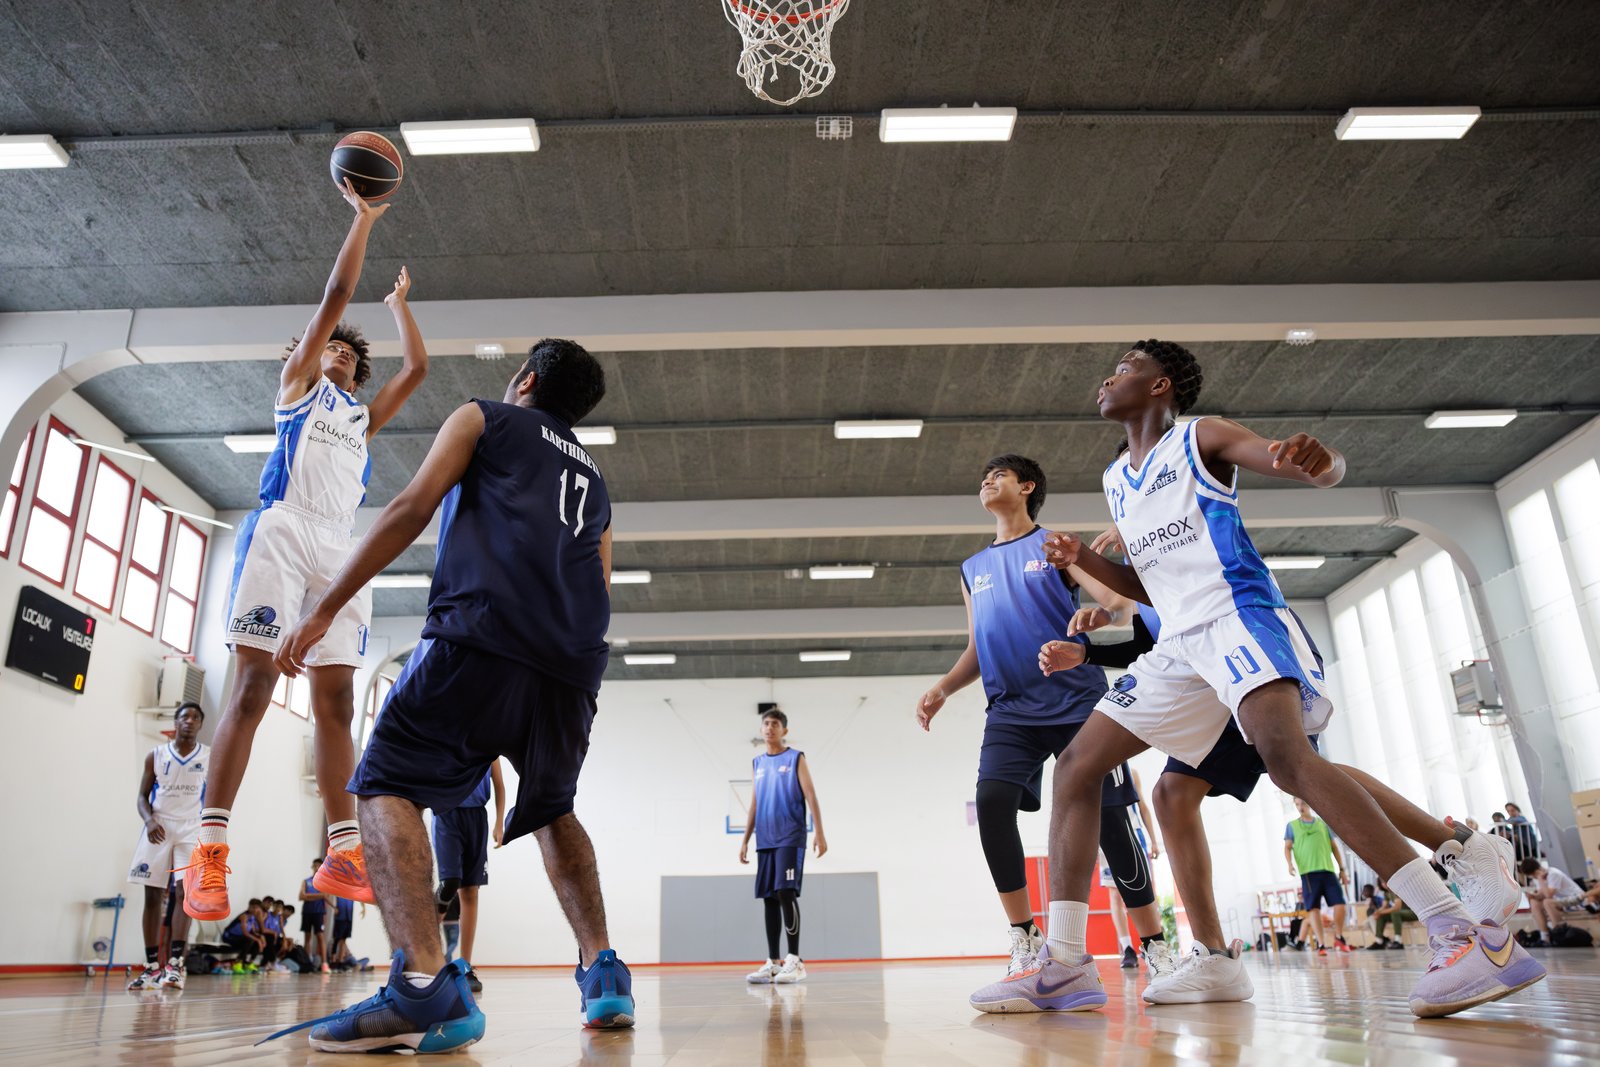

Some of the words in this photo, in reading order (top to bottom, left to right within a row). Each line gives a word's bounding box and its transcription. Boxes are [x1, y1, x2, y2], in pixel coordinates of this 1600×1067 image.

[1157, 470, 1177, 490] MEE
[559, 469, 589, 537] 17
[1158, 533, 1199, 555] TERTIAIRE
[22, 606, 52, 632] LOCAUX
[86, 619, 93, 634] 1
[231, 618, 246, 633] LE
[250, 624, 280, 639] MEE
[63, 625, 93, 651] VISITEURS
[74, 673, 84, 690] 0
[786, 869, 794, 881] 11
